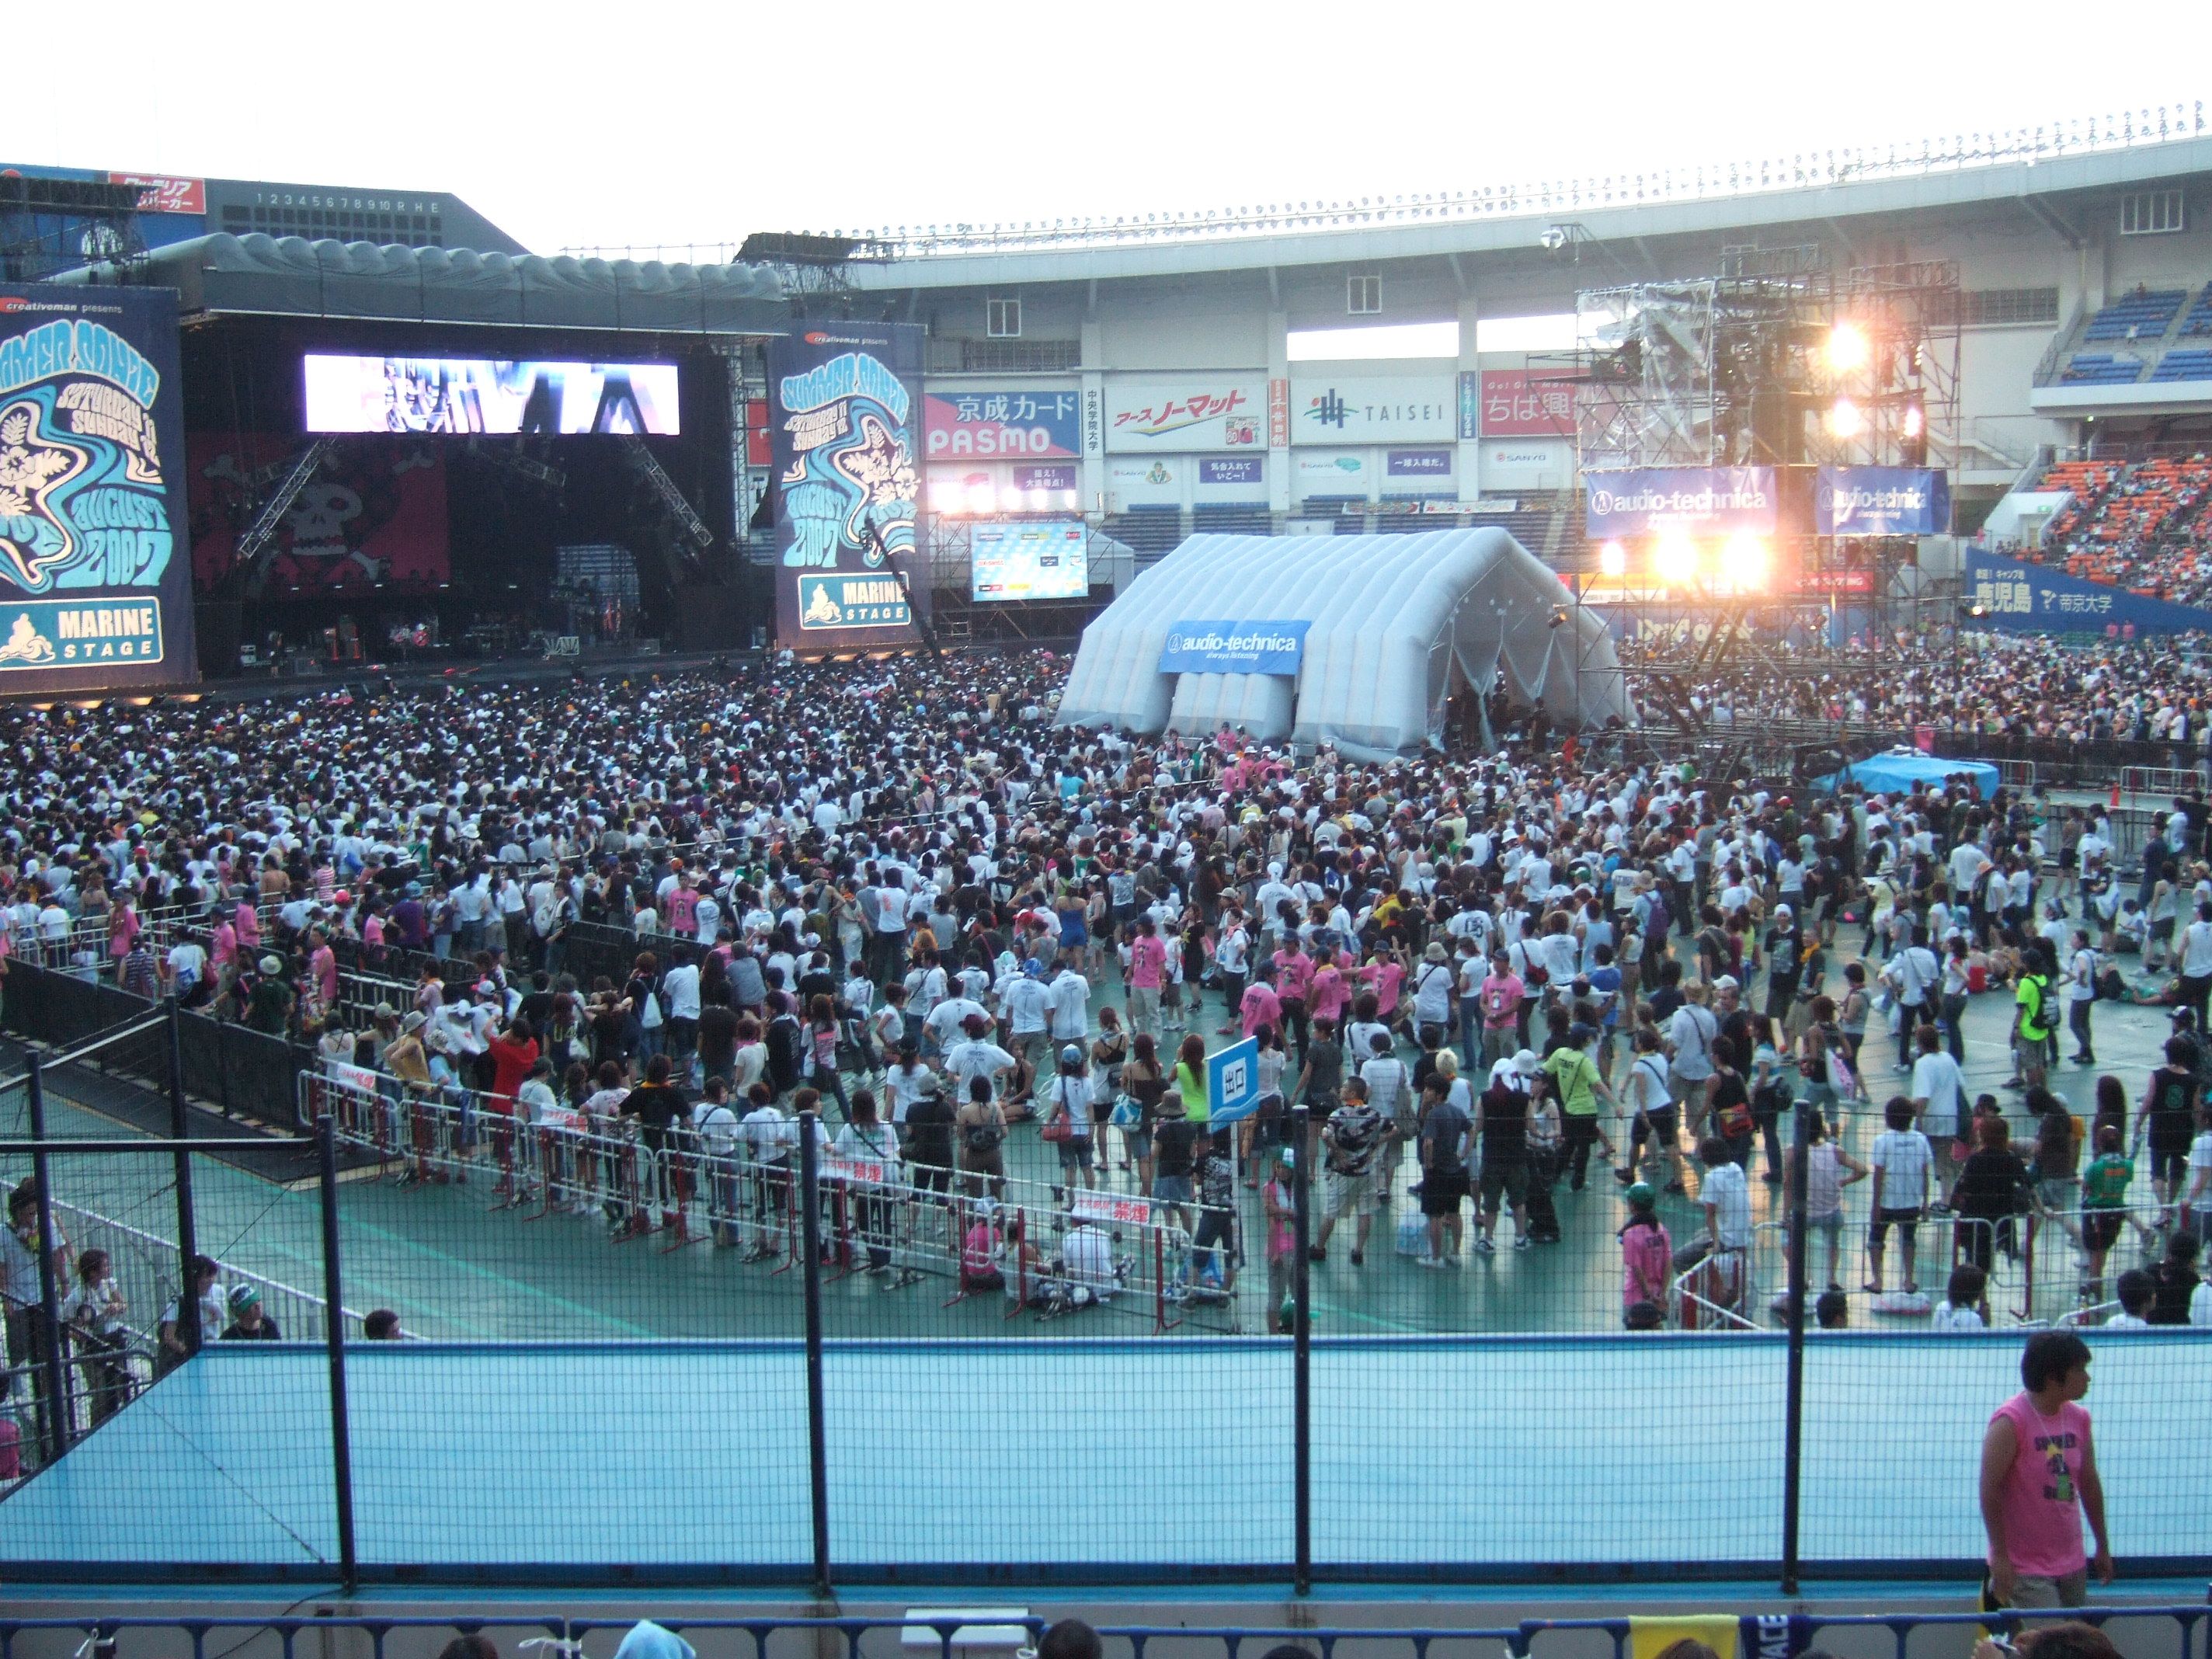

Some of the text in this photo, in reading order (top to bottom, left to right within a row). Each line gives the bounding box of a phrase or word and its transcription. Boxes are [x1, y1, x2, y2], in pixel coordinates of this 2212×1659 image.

[257, 193, 438, 213] 1 2 3 4 5 6 7 8 9 10 R H E
[75, 318, 160, 410] SONIC
[781, 353, 909, 426] SUMMER SONIC
[56, 383, 142, 432] SATURDAY
[956, 395, 1073, 423] 京成カード
[1088, 390, 1098, 450] 中央学院大学
[1365, 405, 1442, 421] TAISEI
[71, 409, 141, 451] SUNDAY
[928, 427, 1050, 454] PASMO
[71, 489, 170, 530] AUGUST
[786, 484, 849, 520] AUGUST
[1614, 487, 1767, 512] audio-technica
[784, 518, 840, 567] 2007
[56, 529, 173, 588] 2007
[847, 608, 905, 620] STAGE
[2060, 593, 2113, 613] 帝京大学
[58, 607, 154, 638] MARINE
[64, 641, 151, 658] STAGE
[1182, 633, 1296, 652] audio-technica
[1225, 1067, 1244, 1096] 出口
[854, 1161, 881, 1182] 禁煙
[1114, 1201, 1149, 1223] 禁煙
